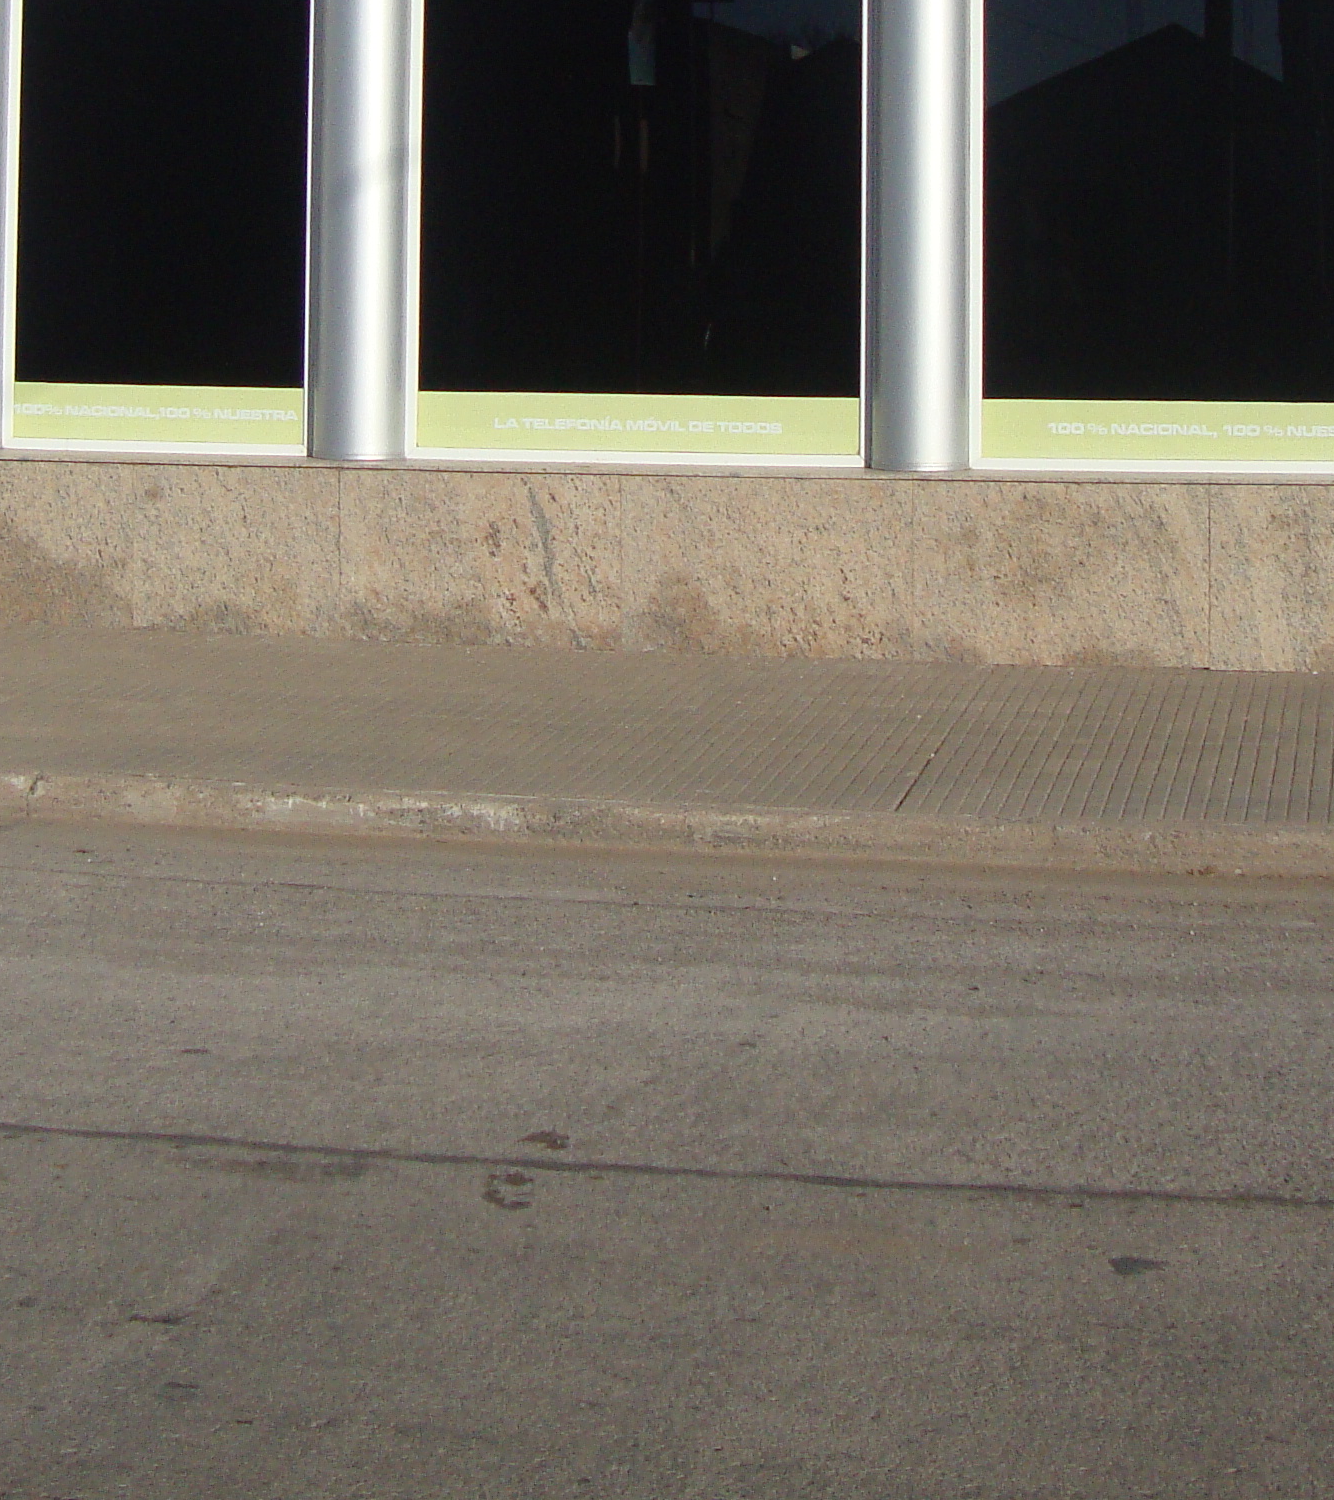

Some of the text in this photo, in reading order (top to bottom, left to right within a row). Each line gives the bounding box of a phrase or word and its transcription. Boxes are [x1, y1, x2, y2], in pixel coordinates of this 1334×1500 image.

[213, 407, 299, 421] NUESTRA
[493, 415, 783, 434] LA TELEFONÍA MÓVIL DE TODOS
